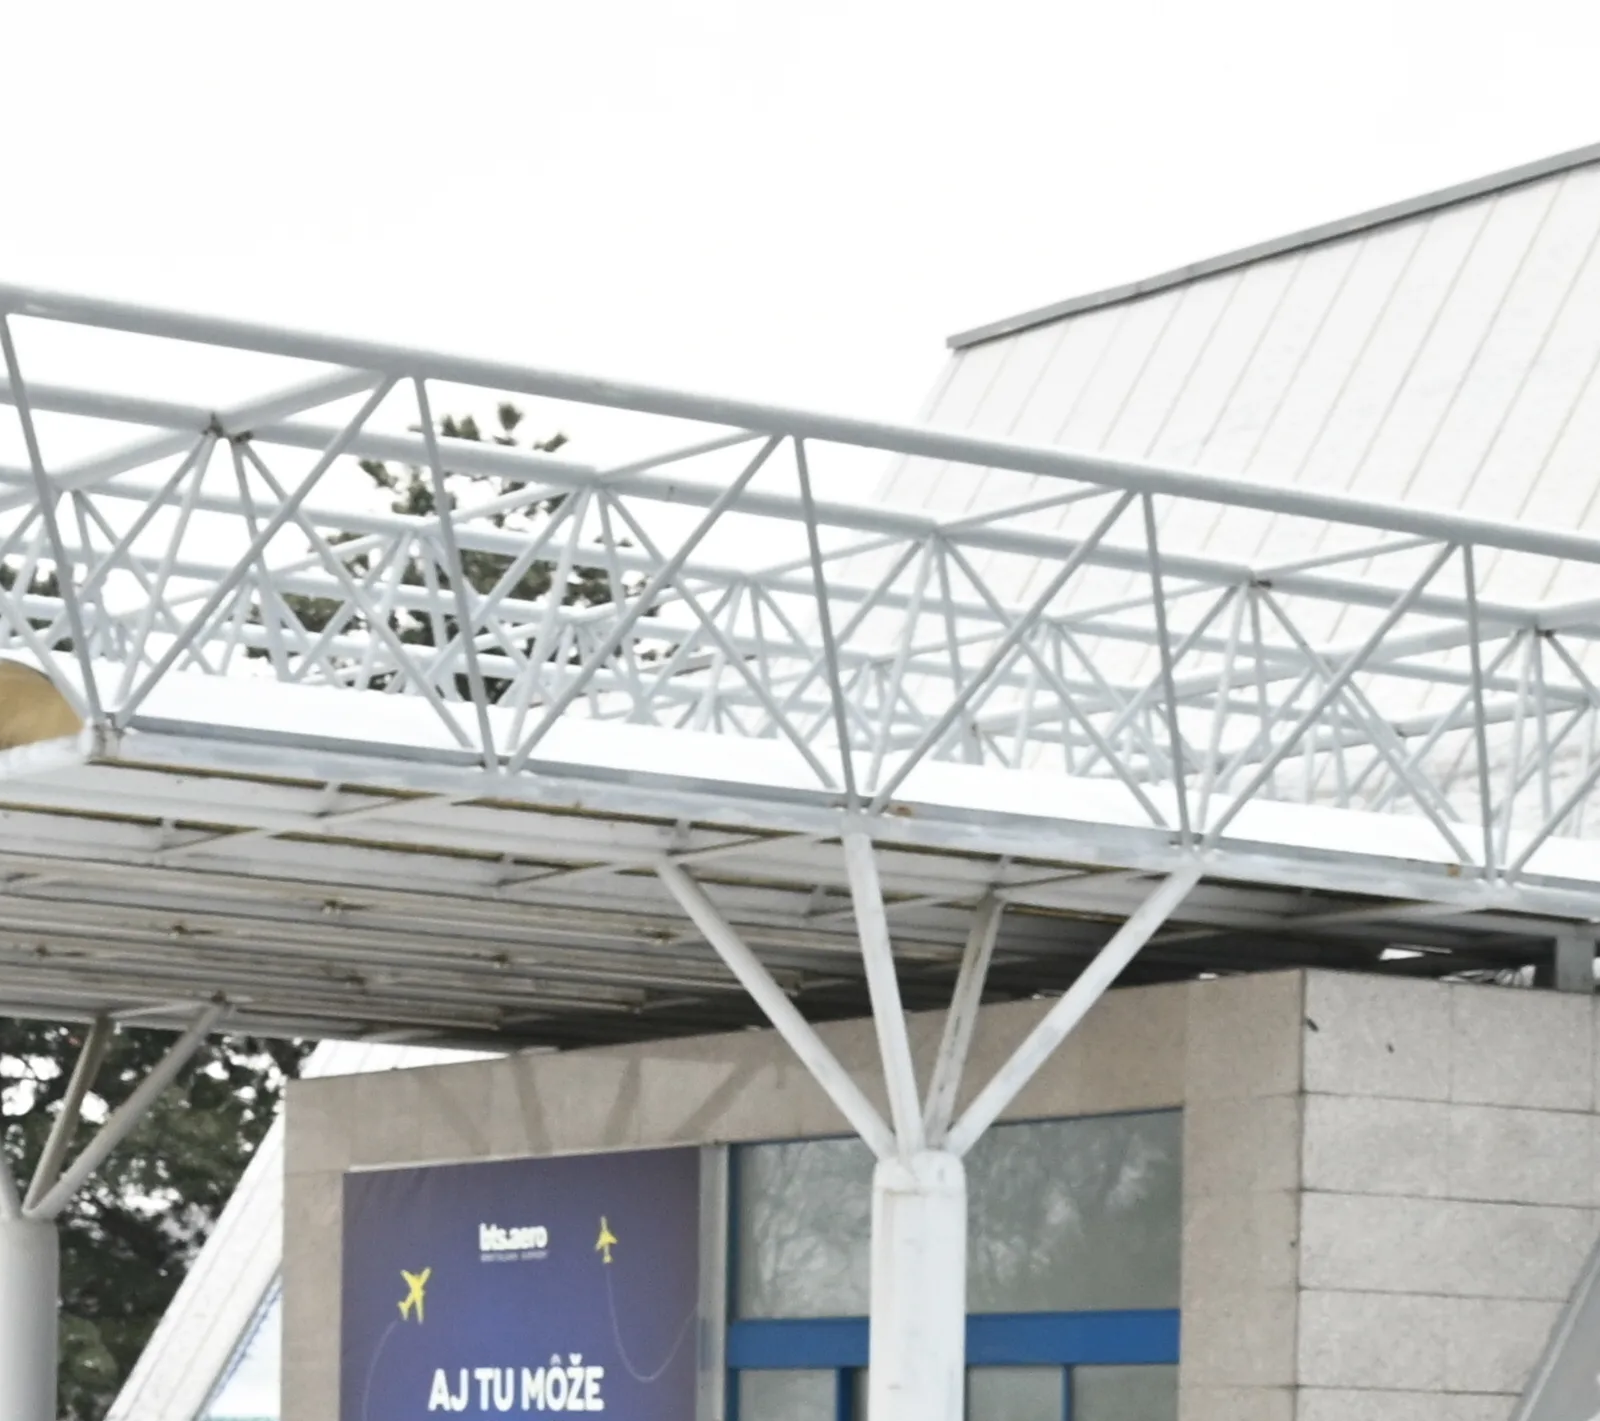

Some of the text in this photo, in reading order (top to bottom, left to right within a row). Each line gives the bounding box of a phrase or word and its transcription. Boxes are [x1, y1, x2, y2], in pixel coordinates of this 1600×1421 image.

[479, 1222, 548, 1251] bts.aero
[428, 1354, 605, 1412] AJ TU MÔŽE
